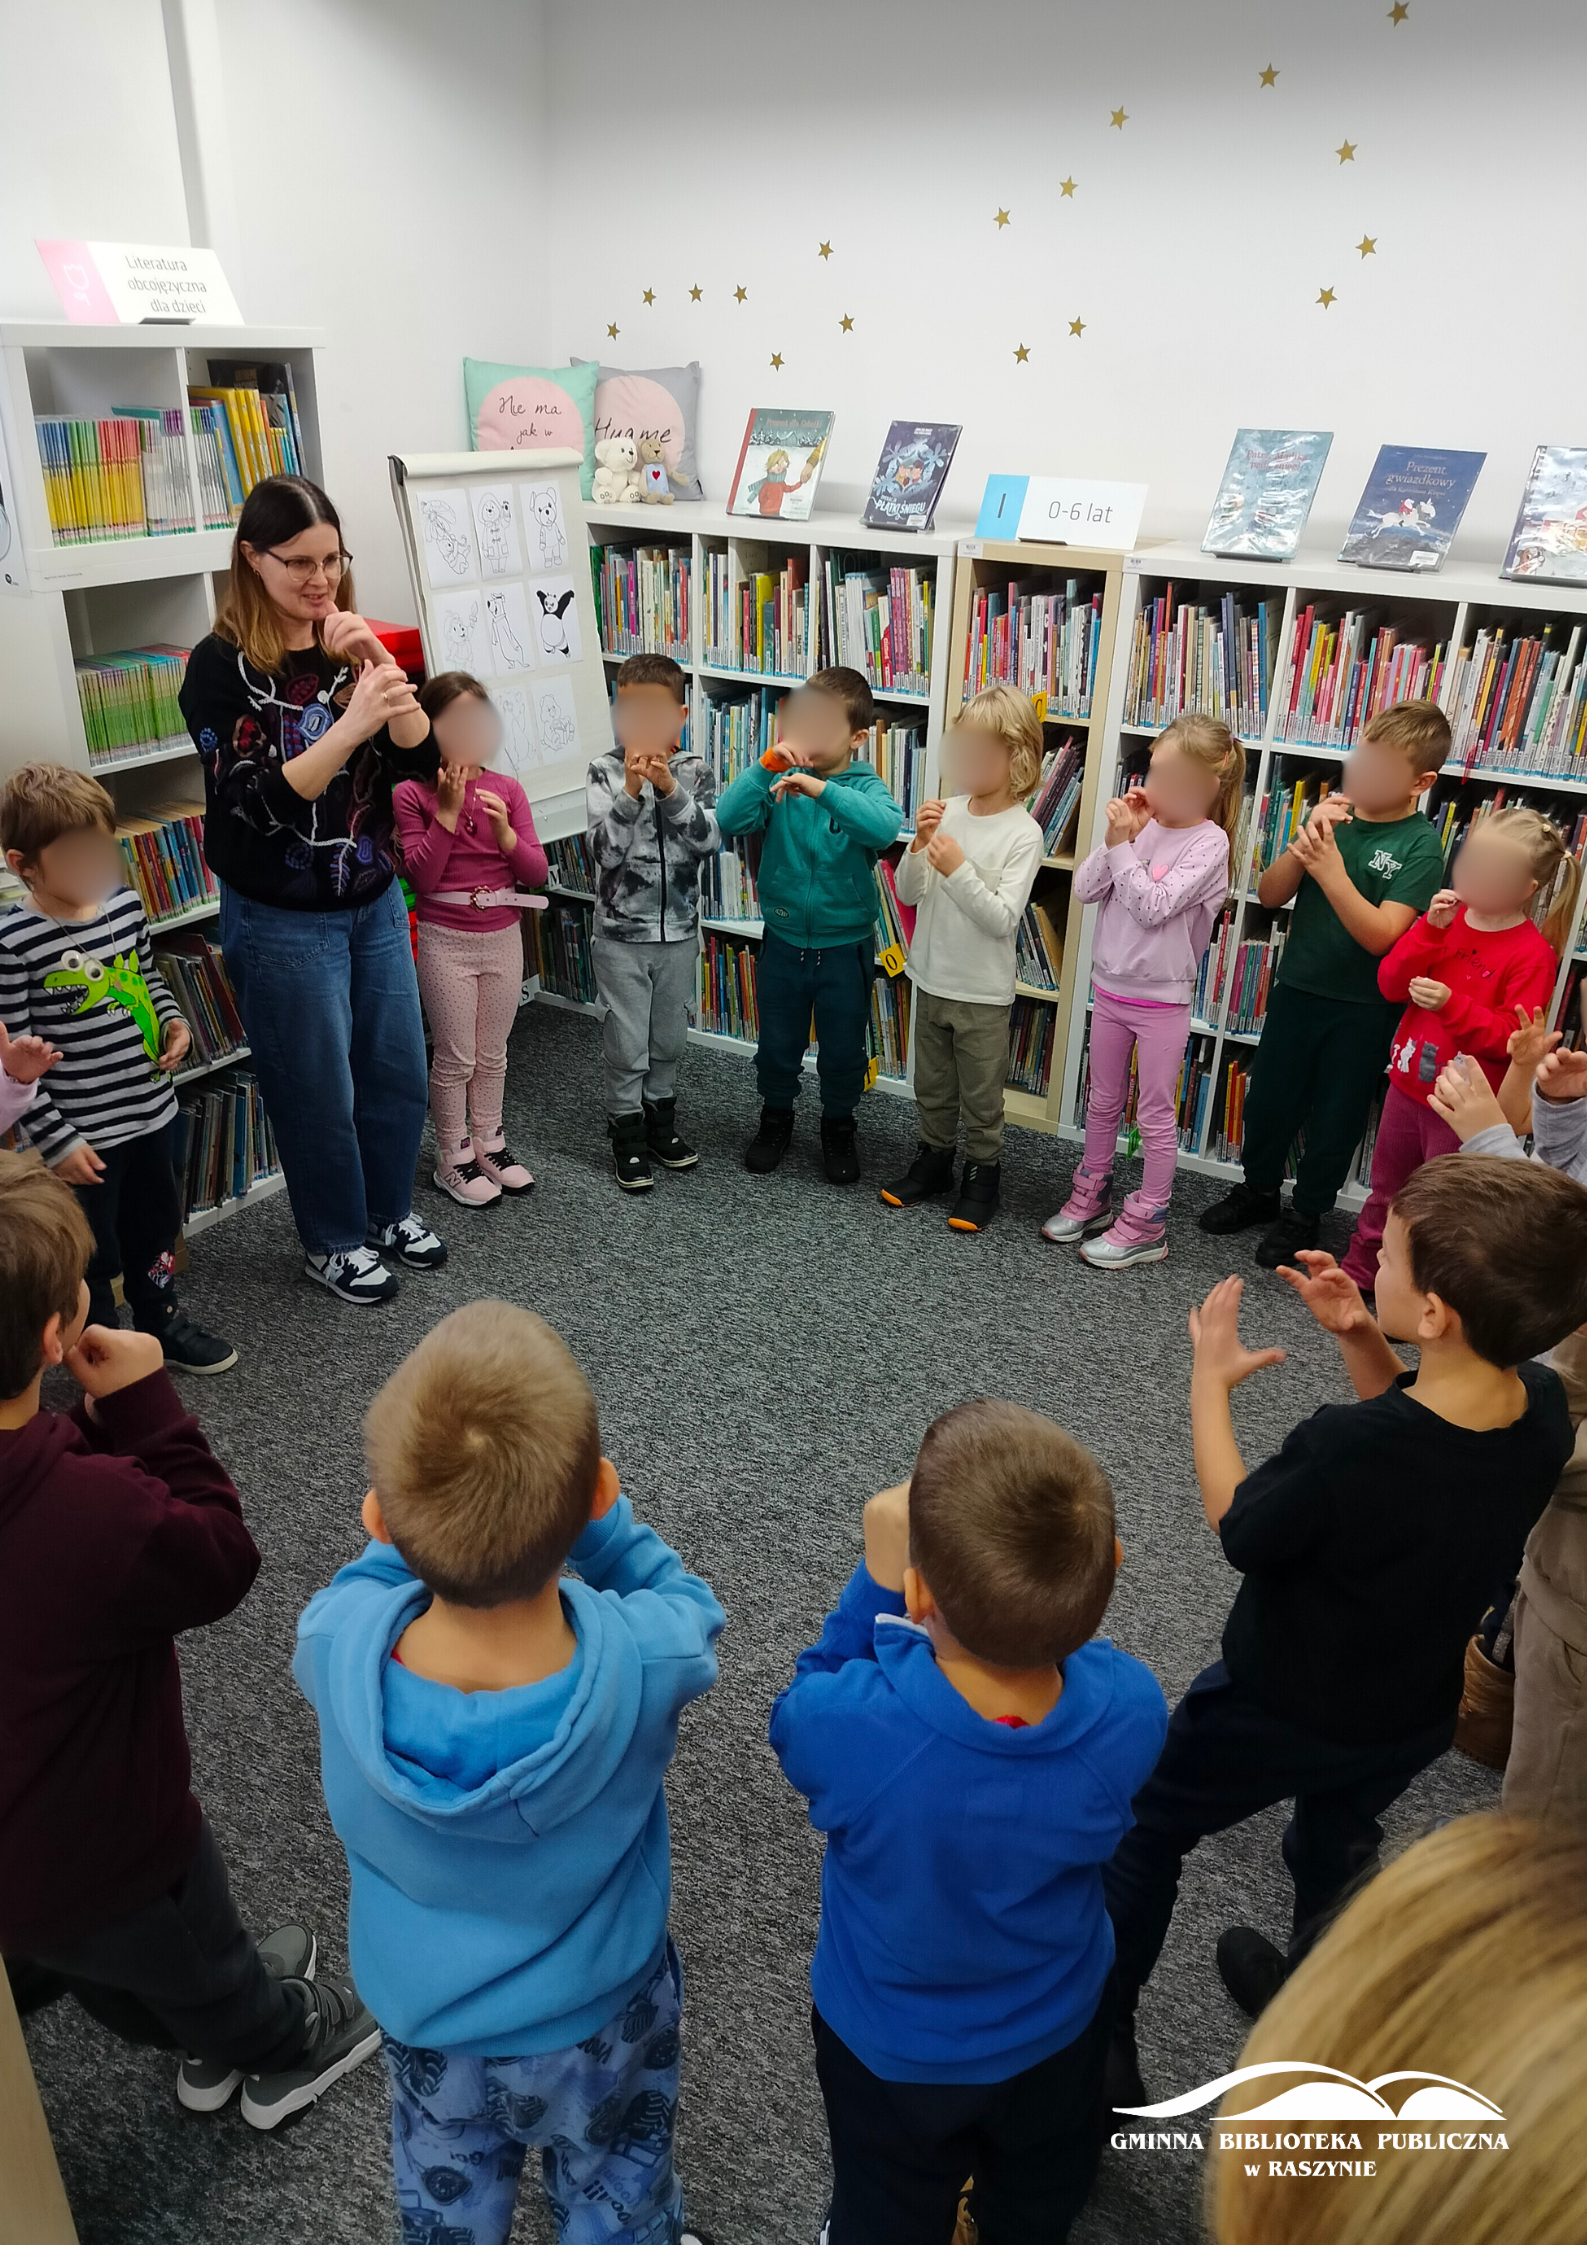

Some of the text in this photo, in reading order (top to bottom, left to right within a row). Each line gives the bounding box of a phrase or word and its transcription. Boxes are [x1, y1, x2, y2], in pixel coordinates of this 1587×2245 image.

[125, 255, 188, 271] Literatura
[127, 276, 207, 295] obcojęzyczna
[150, 298, 206, 313] dla dzieci
[499, 395, 562, 417] Nie ma
[516, 422, 538, 444] jak
[639, 427, 673, 443] me
[1406, 461, 1447, 474] Prezent
[1385, 473, 1456, 490] gwiazdkowy
[1048, 501, 1113, 523] 0-6 lat
[1368, 849, 1403, 880] NY
